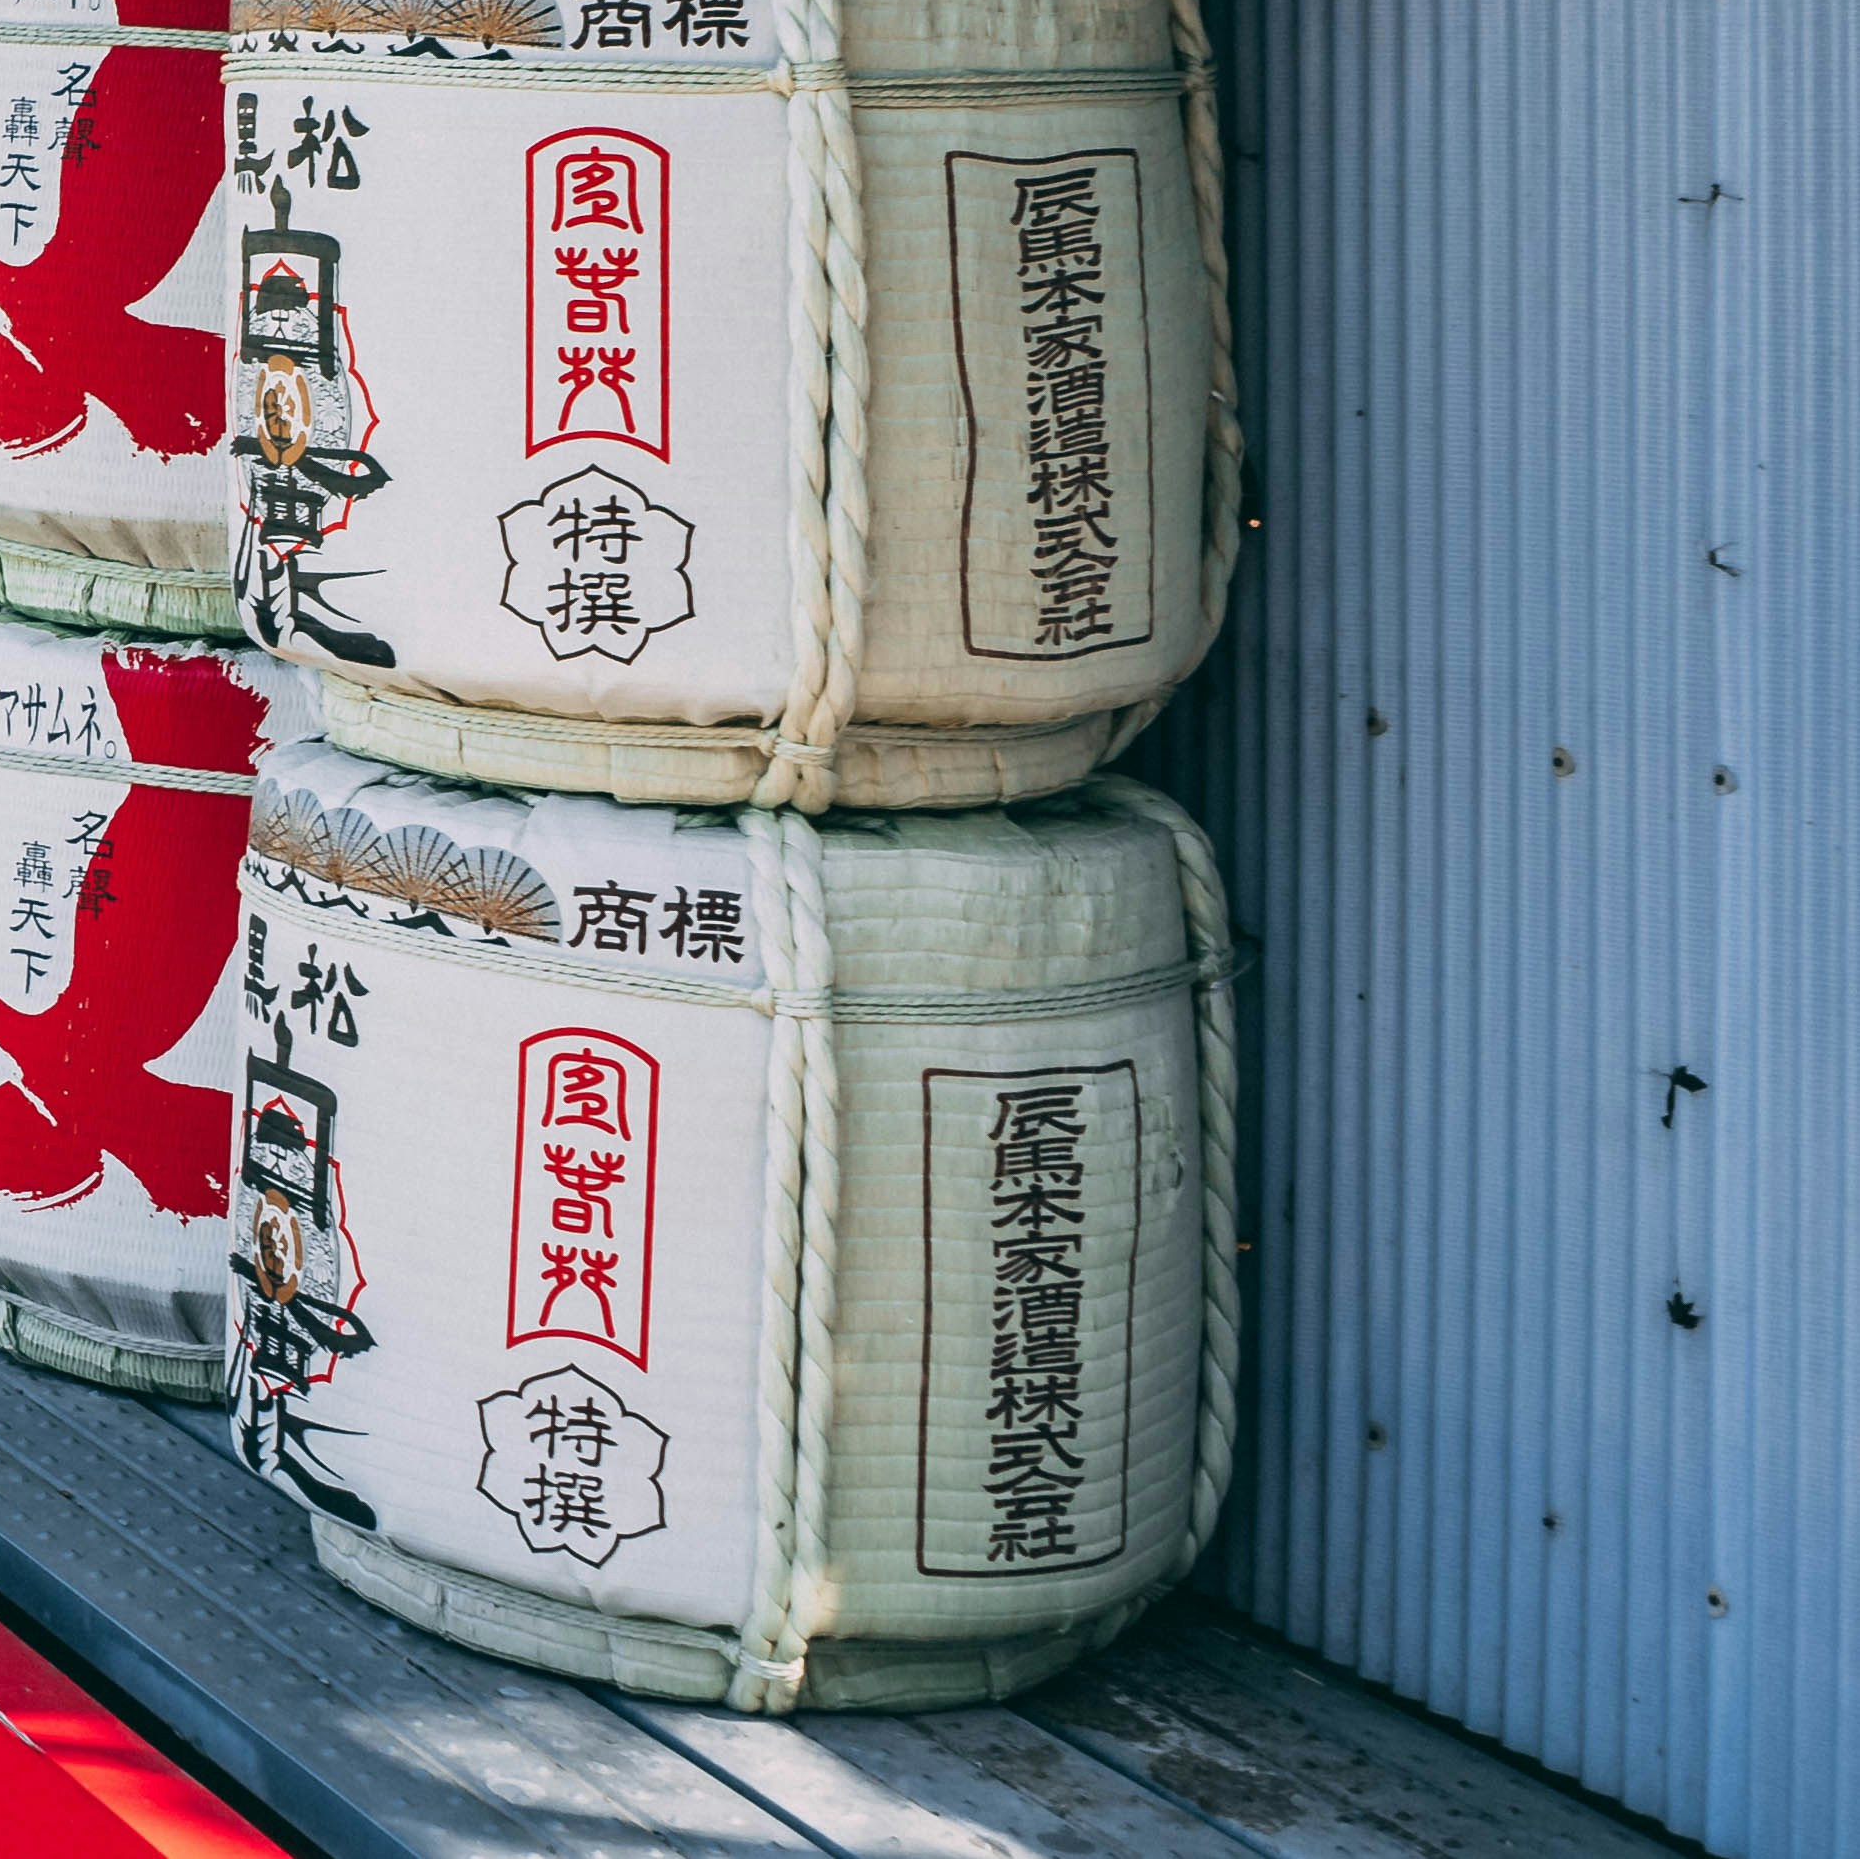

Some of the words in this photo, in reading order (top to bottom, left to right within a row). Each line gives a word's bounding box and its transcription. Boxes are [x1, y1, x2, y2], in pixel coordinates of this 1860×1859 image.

[234, 91, 370, 194] 黒松
[1010, 166, 1117, 645] 辰馬本家酒造株式会社
[547, 495, 641, 635] 特撰
[243, 914, 368, 1048] 黒松
[568, 880, 745, 963] 商標
[983, 1085, 1086, 1562] 辰馬本家酒造株式会社
[523, 1395, 617, 1539] 特撰
